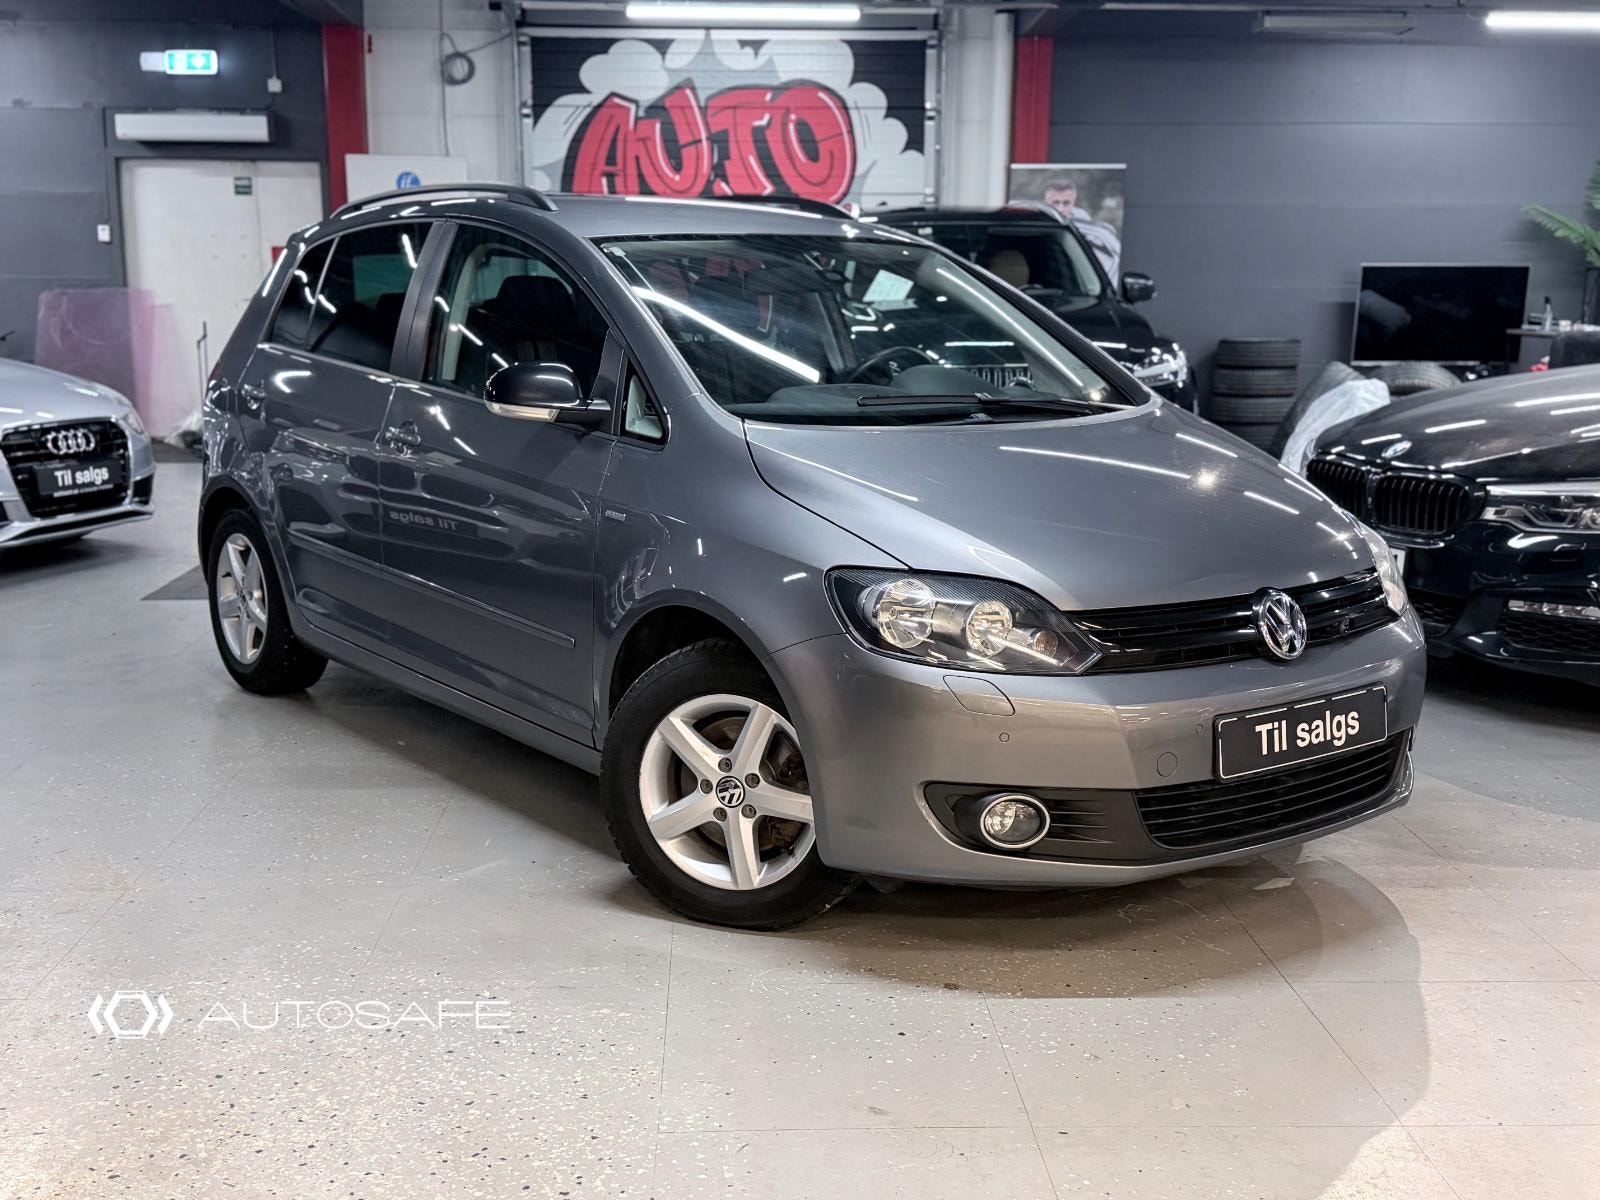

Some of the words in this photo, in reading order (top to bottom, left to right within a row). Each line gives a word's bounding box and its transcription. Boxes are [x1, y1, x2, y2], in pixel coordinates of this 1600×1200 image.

[566, 82, 855, 204] AUTO
[53, 469, 73, 488] Til
[75, 465, 110, 485] salgs
[1255, 720, 1288, 755] Til
[1296, 710, 1360, 748] salgs
